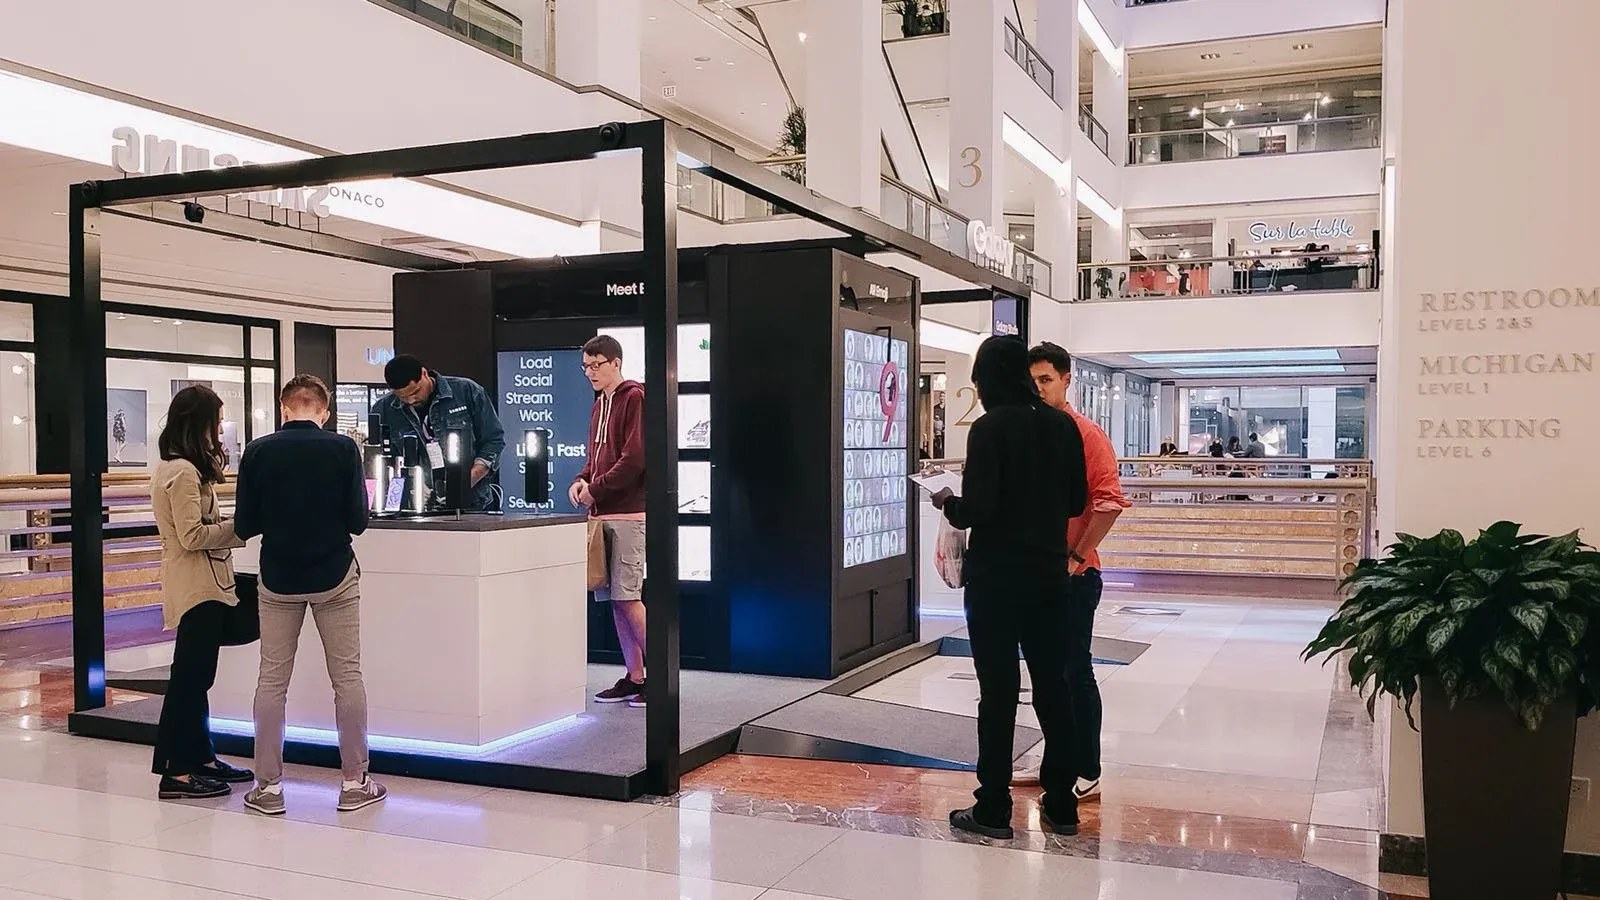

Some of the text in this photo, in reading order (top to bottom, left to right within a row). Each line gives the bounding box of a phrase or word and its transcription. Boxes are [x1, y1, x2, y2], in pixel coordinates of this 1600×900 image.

[958, 147, 983, 188] 3
[329, 186, 385, 208] ONACO
[1249, 217, 1354, 243] Sur la table
[606, 283, 638, 296] Meet
[1418, 316, 1533, 332] LEVELS 2&5
[520, 356, 553, 369] Load
[1419, 352, 1595, 376] MICHIGAN
[514, 373, 553, 387] Social
[1418, 382, 1475, 395] LEVEL
[505, 392, 553, 405] Stream
[954, 386, 979, 427] 2
[519, 409, 553, 422] Work
[1418, 418, 1561, 439] PARKING
[557, 443, 586, 457] Fast
[1417, 446, 1492, 459] LEVEL 6
